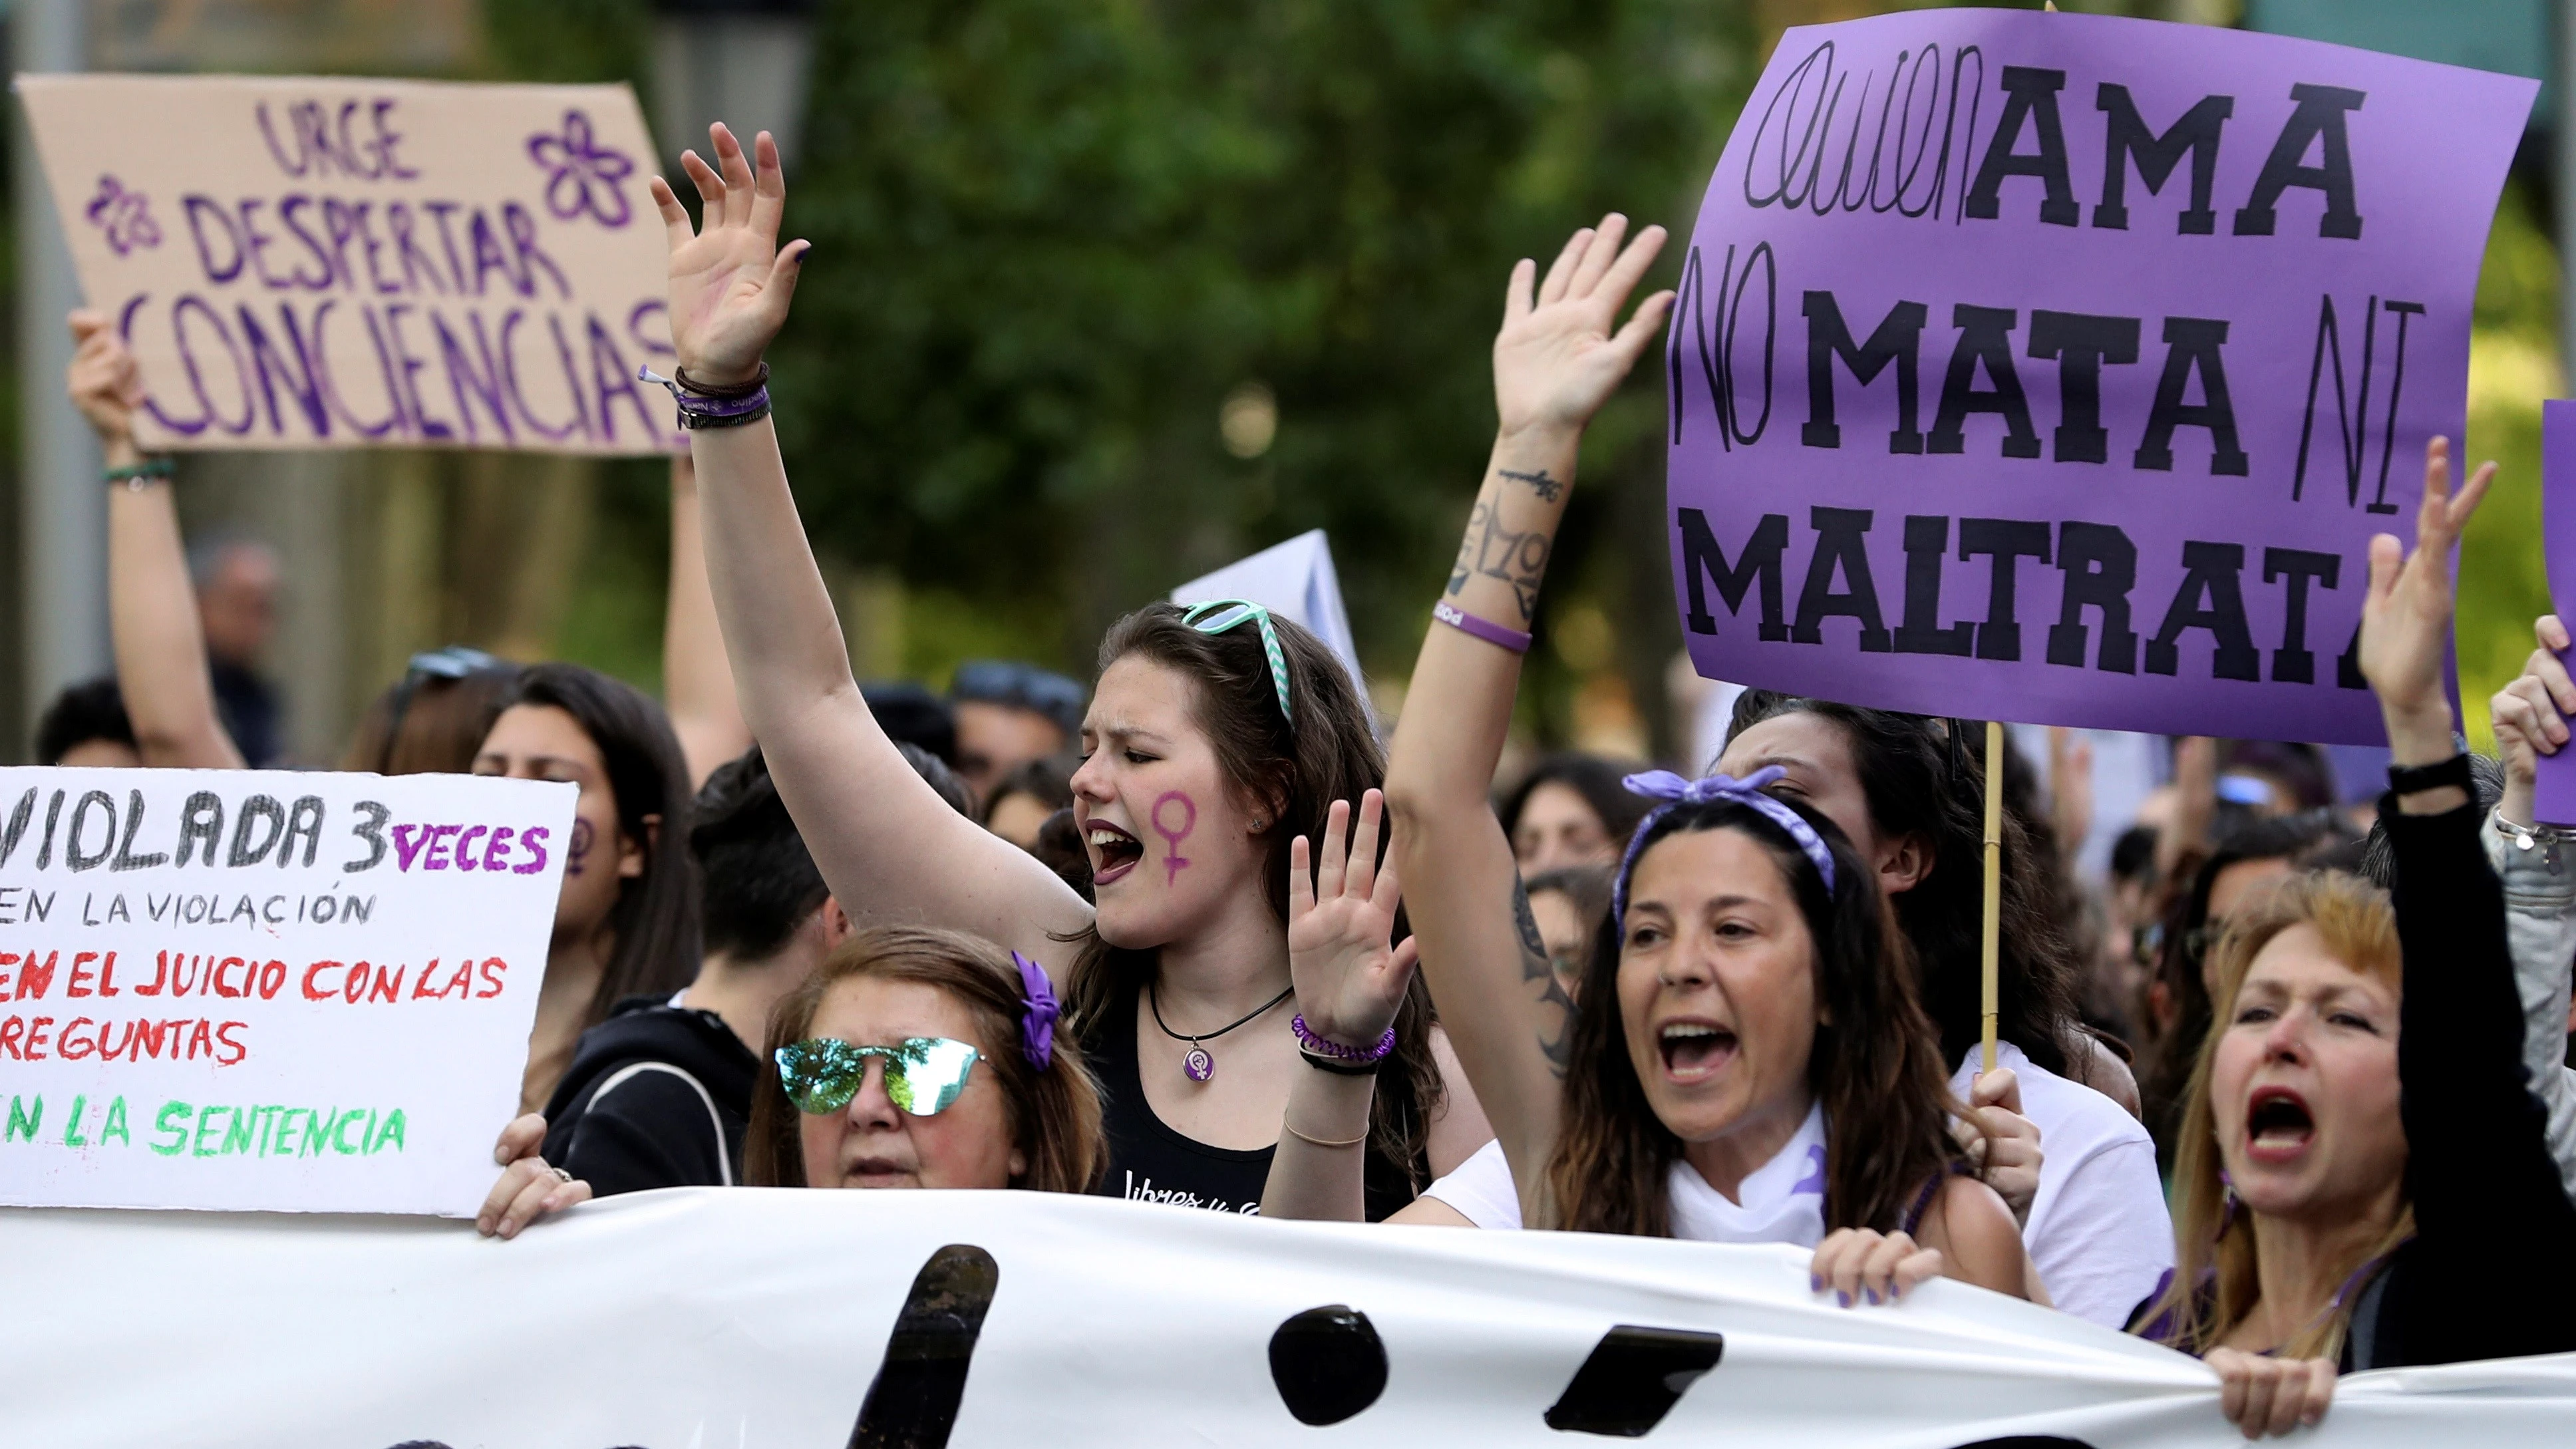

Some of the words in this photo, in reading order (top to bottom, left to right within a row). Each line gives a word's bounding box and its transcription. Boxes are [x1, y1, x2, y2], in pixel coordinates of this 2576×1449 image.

[255, 100, 422, 180] URGE
[1966, 65, 2366, 240] AMA
[181, 194, 571, 299] DESPERTAR
[1674, 240, 1776, 452] NO
[1802, 290, 2249, 476] MATA
[2292, 293, 2426, 515] NI
[343, 800, 391, 873] 3
[391, 823, 550, 875] VECES
[0, 887, 57, 923] EN
[82, 891, 130, 926] LA
[147, 880, 377, 929] VIOLACIÓN
[67, 951, 120, 998] EL
[134, 949, 287, 1000] JUICIO
[301, 960, 405, 1004] CON
[411, 957, 507, 1001] LAS
[65, 1094, 130, 1148] LA
[150, 1100, 406, 1158] SENTENCIA
